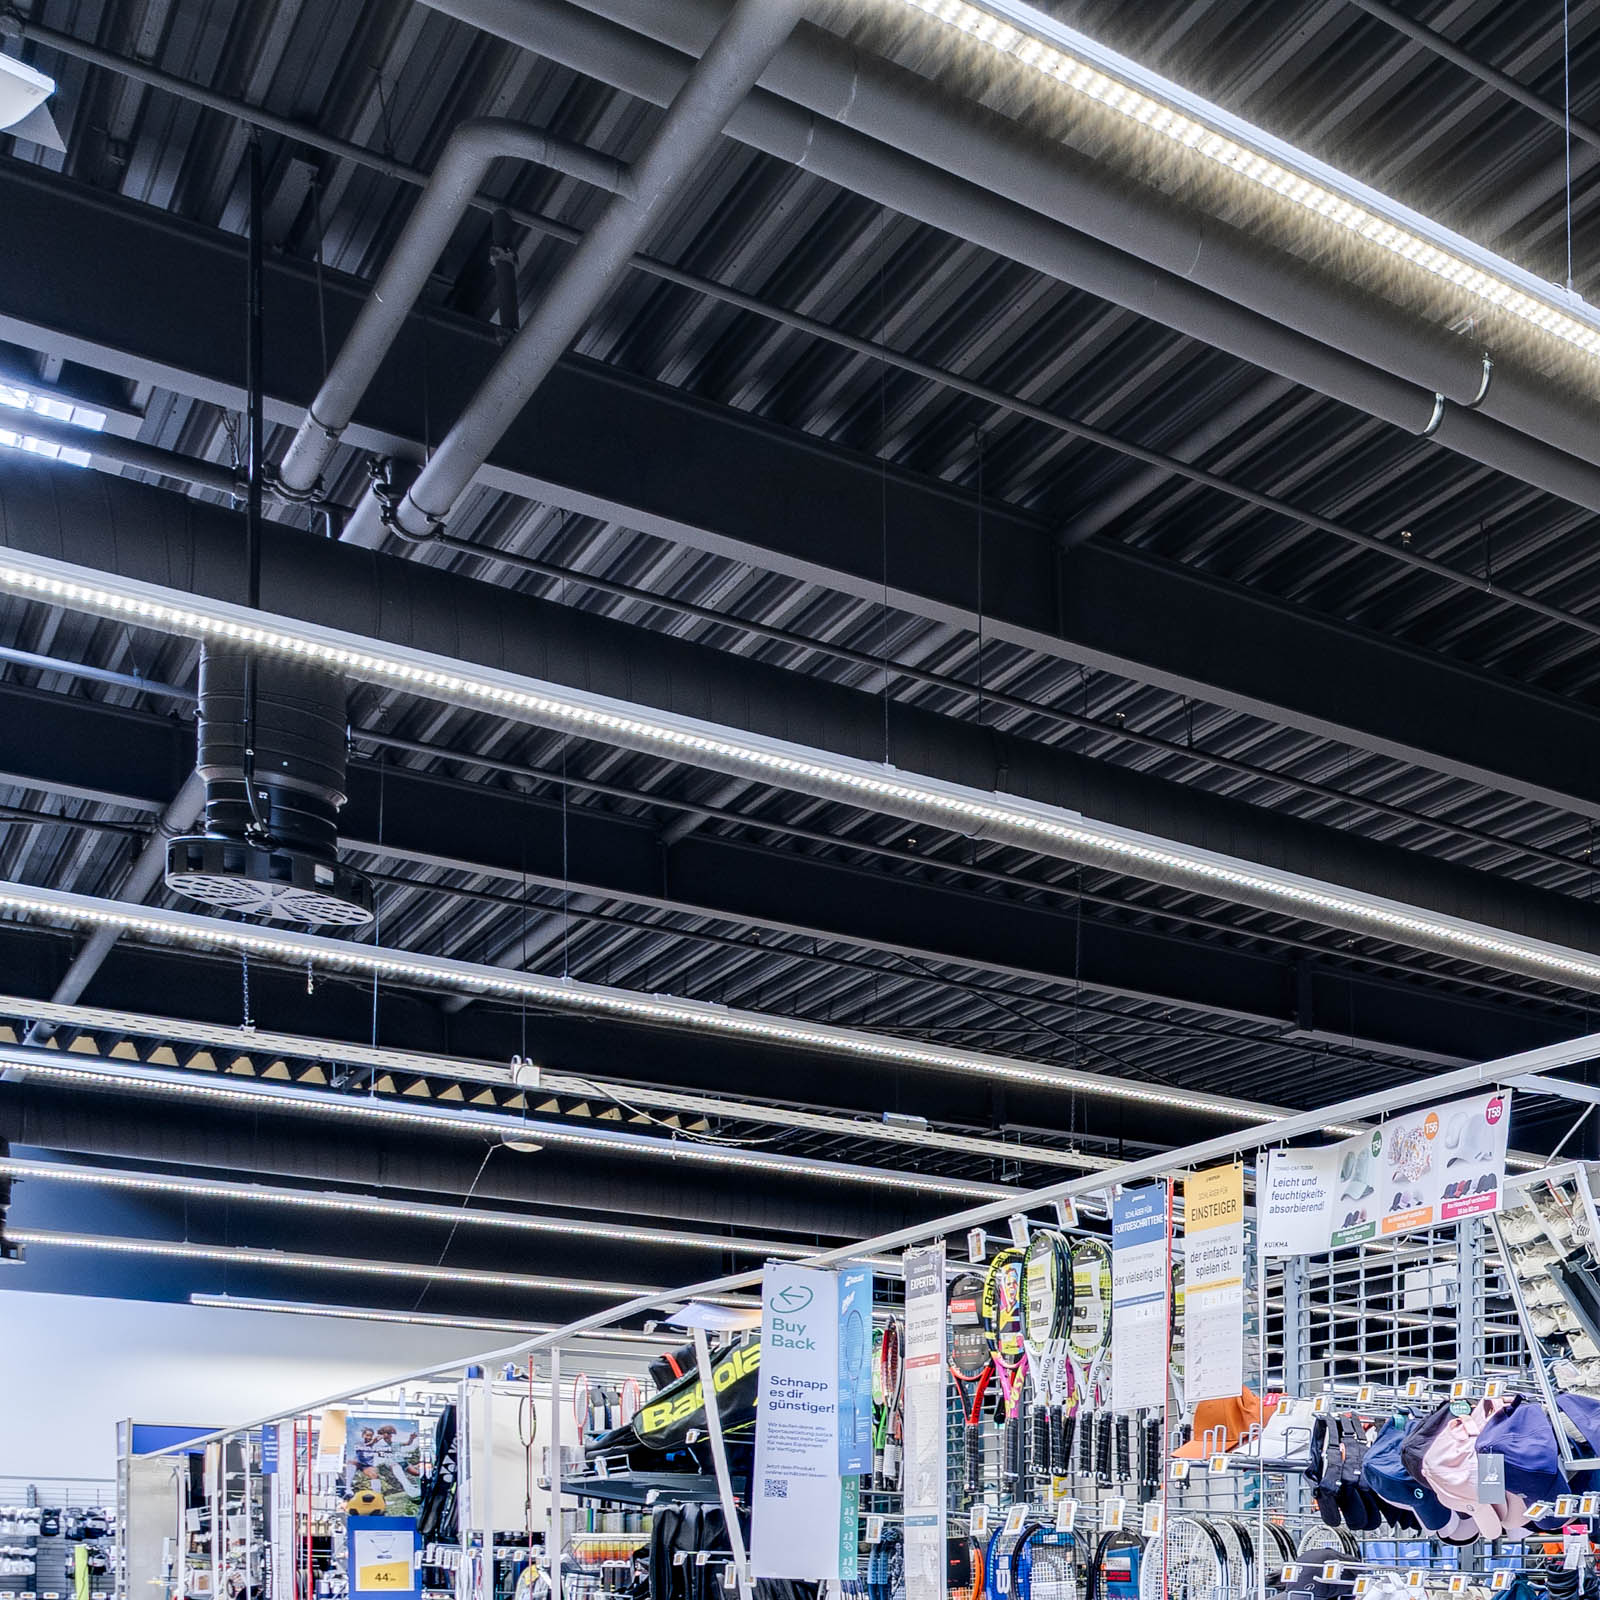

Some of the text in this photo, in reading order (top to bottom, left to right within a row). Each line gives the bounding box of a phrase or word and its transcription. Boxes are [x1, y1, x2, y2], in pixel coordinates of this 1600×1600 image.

[1486, 1106, 1502, 1118] T58
[1272, 1175, 1317, 1187] Leicht und
[1271, 1189, 1327, 1203] feuchtigkeits-
[1191, 1199, 1237, 1221] EINSTEIGER
[1269, 1201, 1325, 1214] absorbierend!
[1114, 1213, 1164, 1234] FORTGESCHRITTENE
[1263, 1240, 1289, 1249] KUIKMA
[1190, 1245, 1238, 1263] der einfach zu
[1195, 1260, 1232, 1279] spielen ist.
[1114, 1275, 1125, 1287] der
[1125, 1268, 1153, 1283] vielseitig
[772, 1318, 807, 1336] Buy
[771, 1335, 816, 1351] Back
[769, 1376, 829, 1391] Schnapp
[769, 1388, 804, 1399] es dir
[768, 1399, 835, 1414] günstiger!
